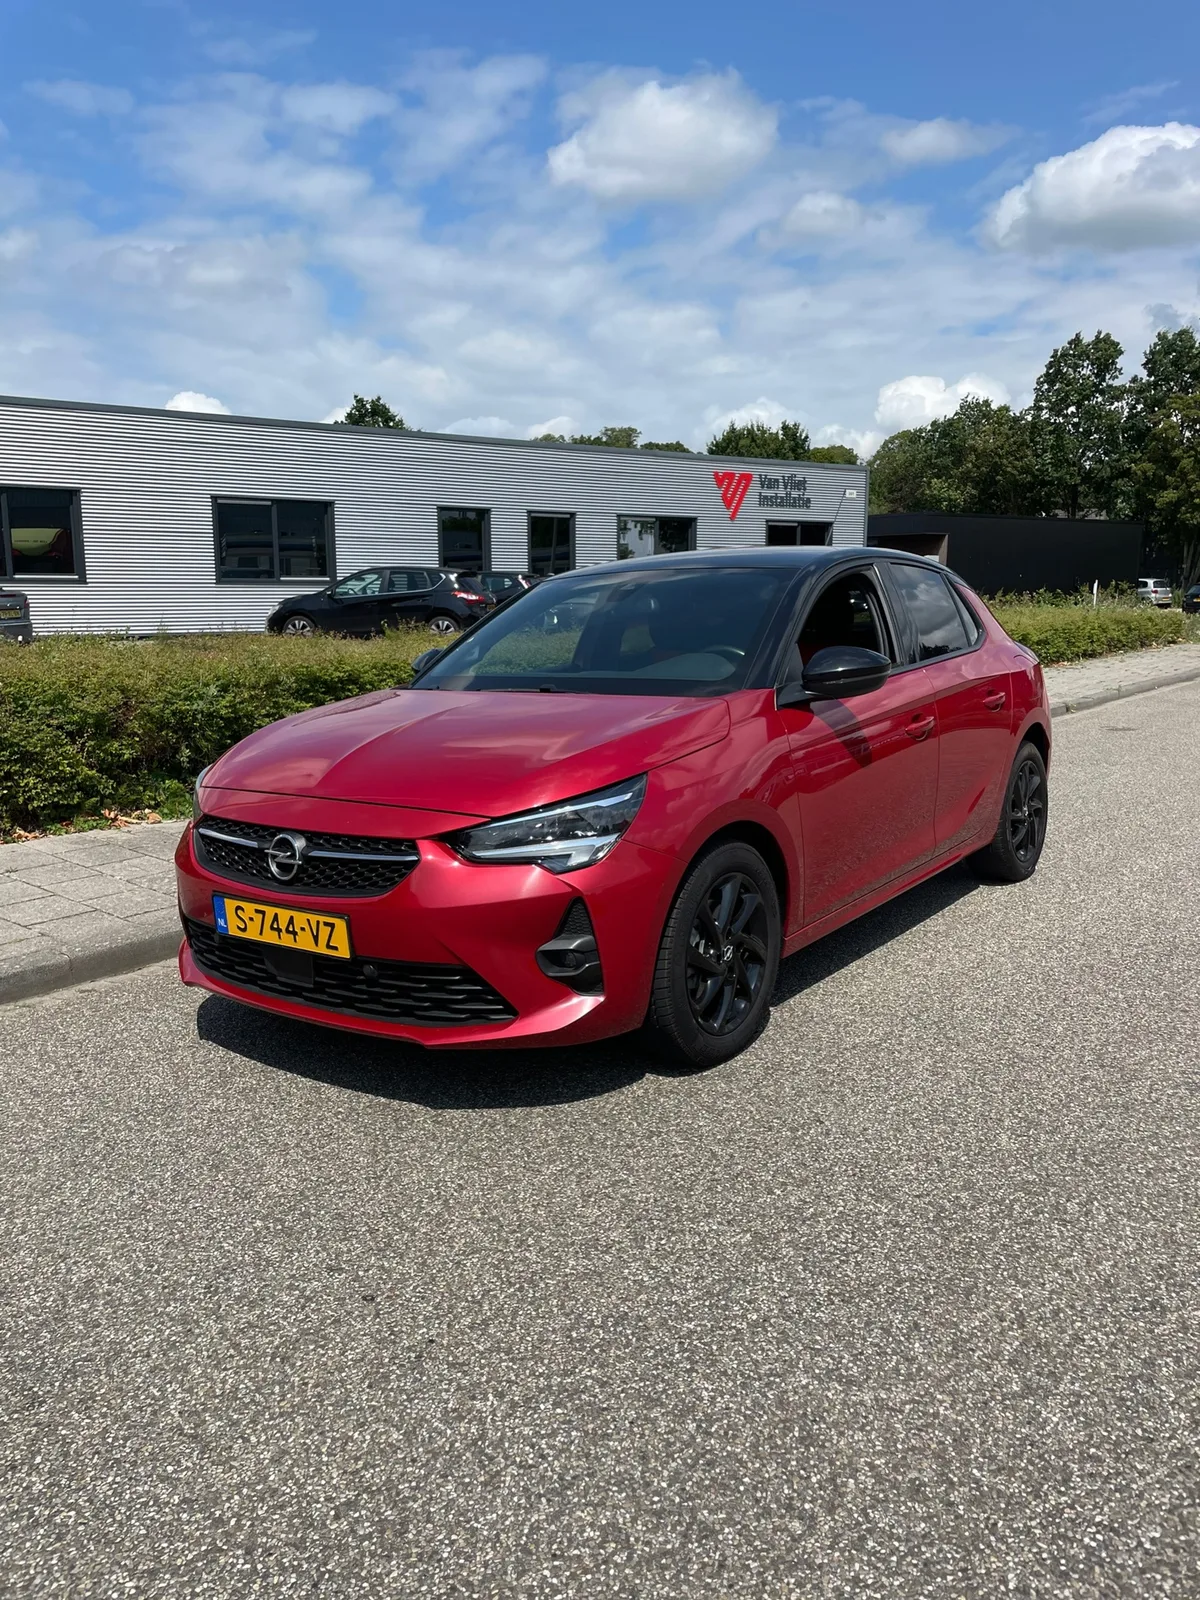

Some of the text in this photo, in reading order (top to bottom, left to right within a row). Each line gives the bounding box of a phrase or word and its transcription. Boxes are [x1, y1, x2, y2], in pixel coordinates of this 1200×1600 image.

[759, 474, 807, 491] Van Vliet
[758, 492, 812, 508] Installatie
[218, 918, 227, 927] NL
[234, 904, 339, 951] S-744-VZ
